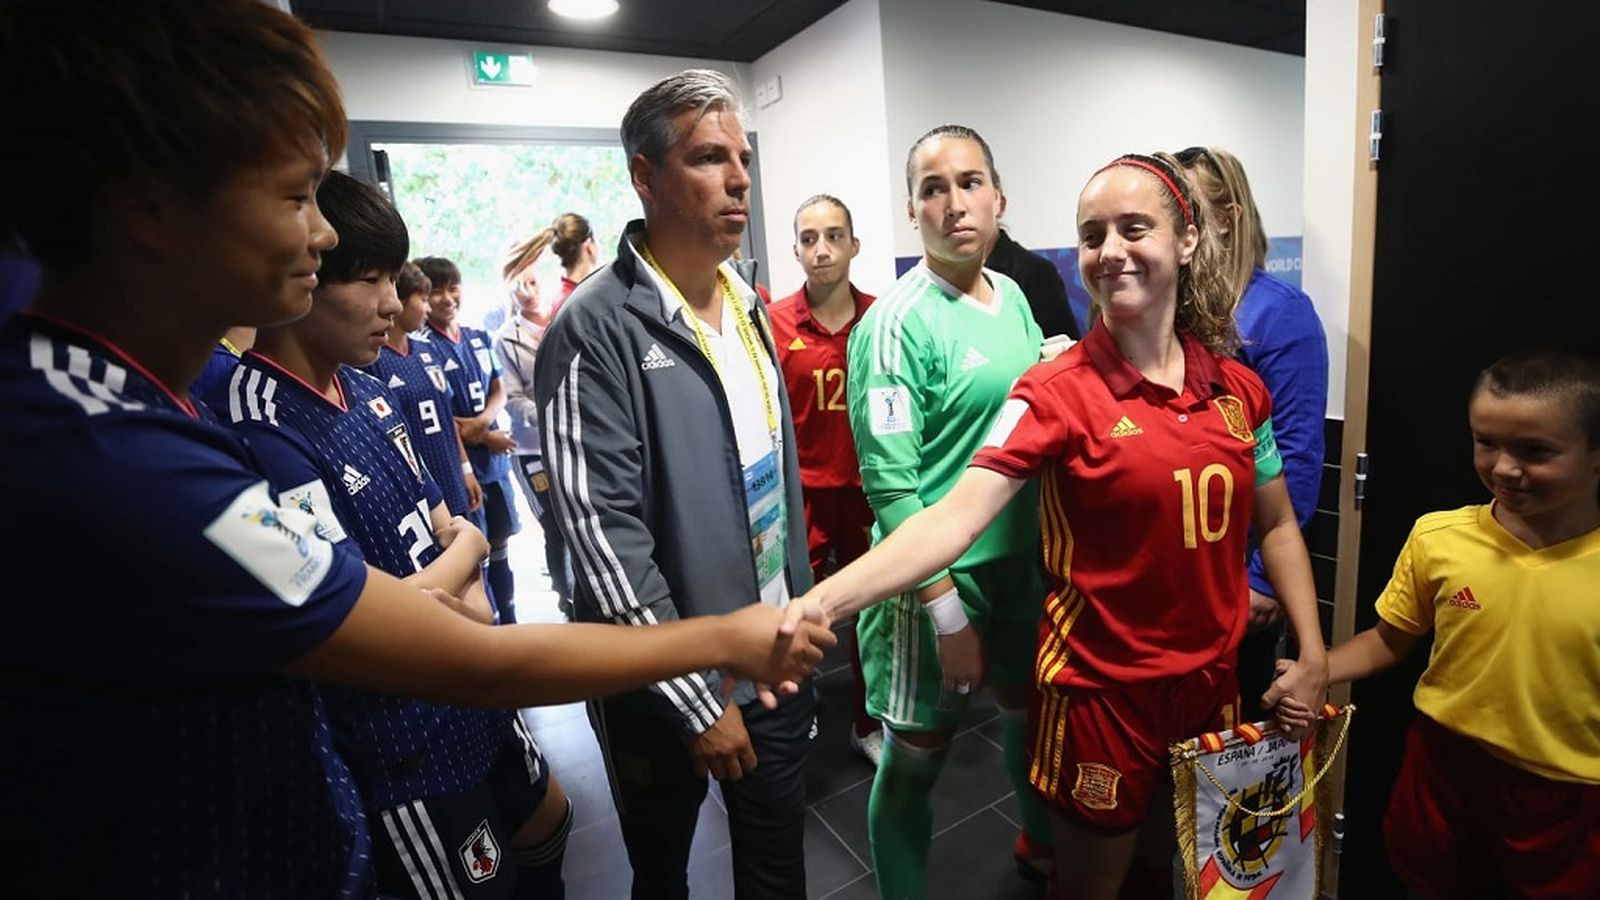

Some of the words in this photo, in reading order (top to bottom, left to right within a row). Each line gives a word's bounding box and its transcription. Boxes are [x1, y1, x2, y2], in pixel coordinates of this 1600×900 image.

[641, 358, 676, 371] adidas
[468, 381, 486, 412] 5
[812, 368, 848, 411] 12
[418, 400, 442, 435] 9
[1110, 427, 1145, 439] adidas
[347, 474, 371, 496] adidas
[1173, 463, 1234, 549] 10
